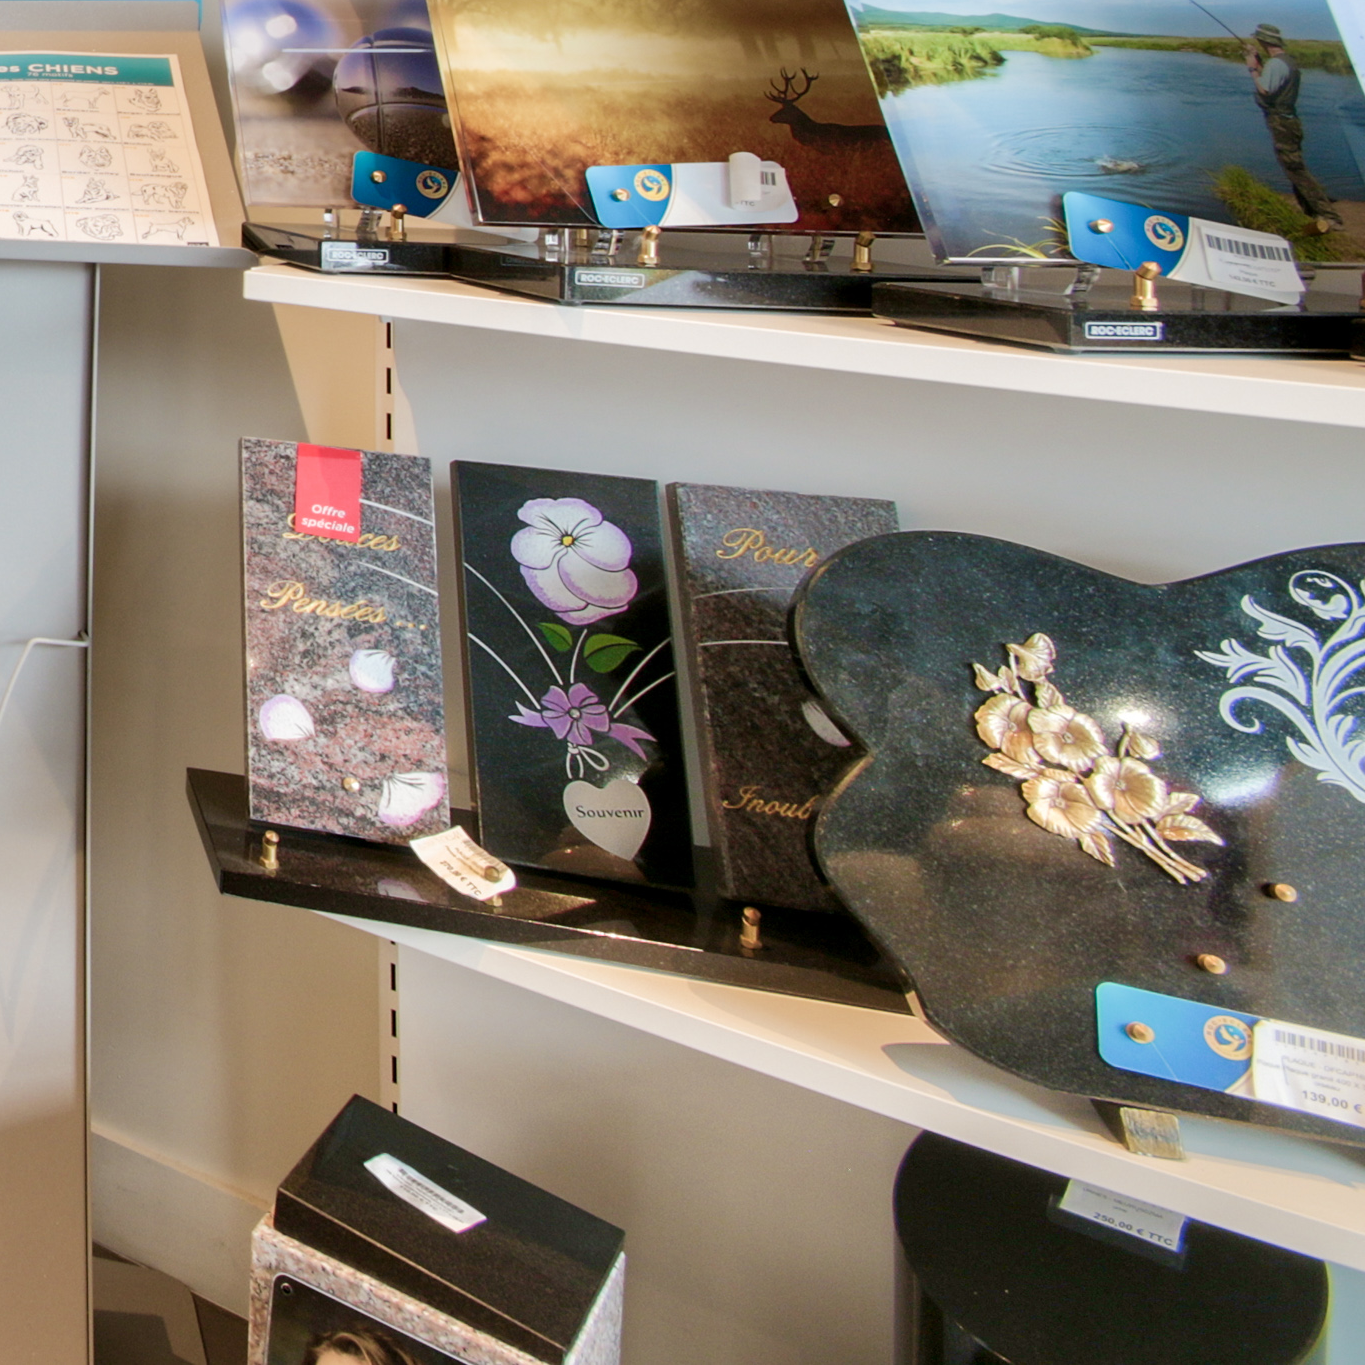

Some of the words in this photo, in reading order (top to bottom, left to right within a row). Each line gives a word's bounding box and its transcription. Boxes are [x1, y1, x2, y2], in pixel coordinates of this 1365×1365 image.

[28, 64, 118, 75] CHIENS
[312, 504, 346, 518] Offre
[301, 516, 355, 534] spéciale
[717, 528, 818, 567] Pour
[260, 580, 387, 623] Pensées
[576, 805, 644, 819] Souvenir
[1302, 1090, 1348, 1109] 139,00
[1093, 1211, 1133, 1231] 250,00
[1149, 1231, 1173, 1246] TTC
